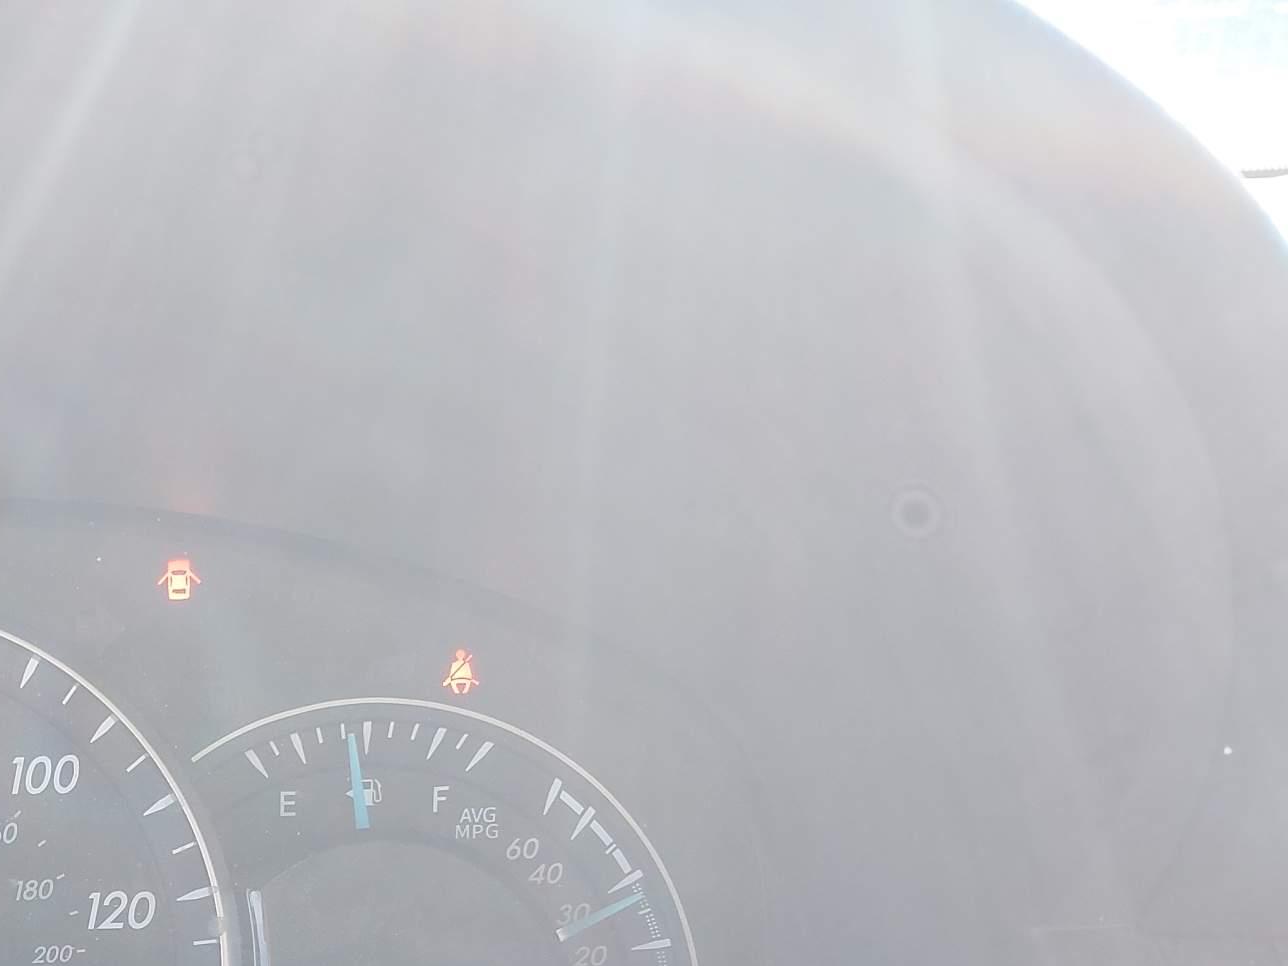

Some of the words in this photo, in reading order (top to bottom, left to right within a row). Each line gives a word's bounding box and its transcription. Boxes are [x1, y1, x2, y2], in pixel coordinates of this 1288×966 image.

[11, 754, 81, 796] 100
[279, 790, 297, 818] E
[431, 785, 450, 813] F
[458, 807, 497, 825] AVG
[454, 823, 500, 840] MPG
[505, 837, 540, 861] 60
[527, 864, 564, 886] 40
[14, 878, 54, 901] 180
[87, 891, 158, 931] 120
[558, 902, 591, 926] 30
[32, 945, 73, 964] 200
